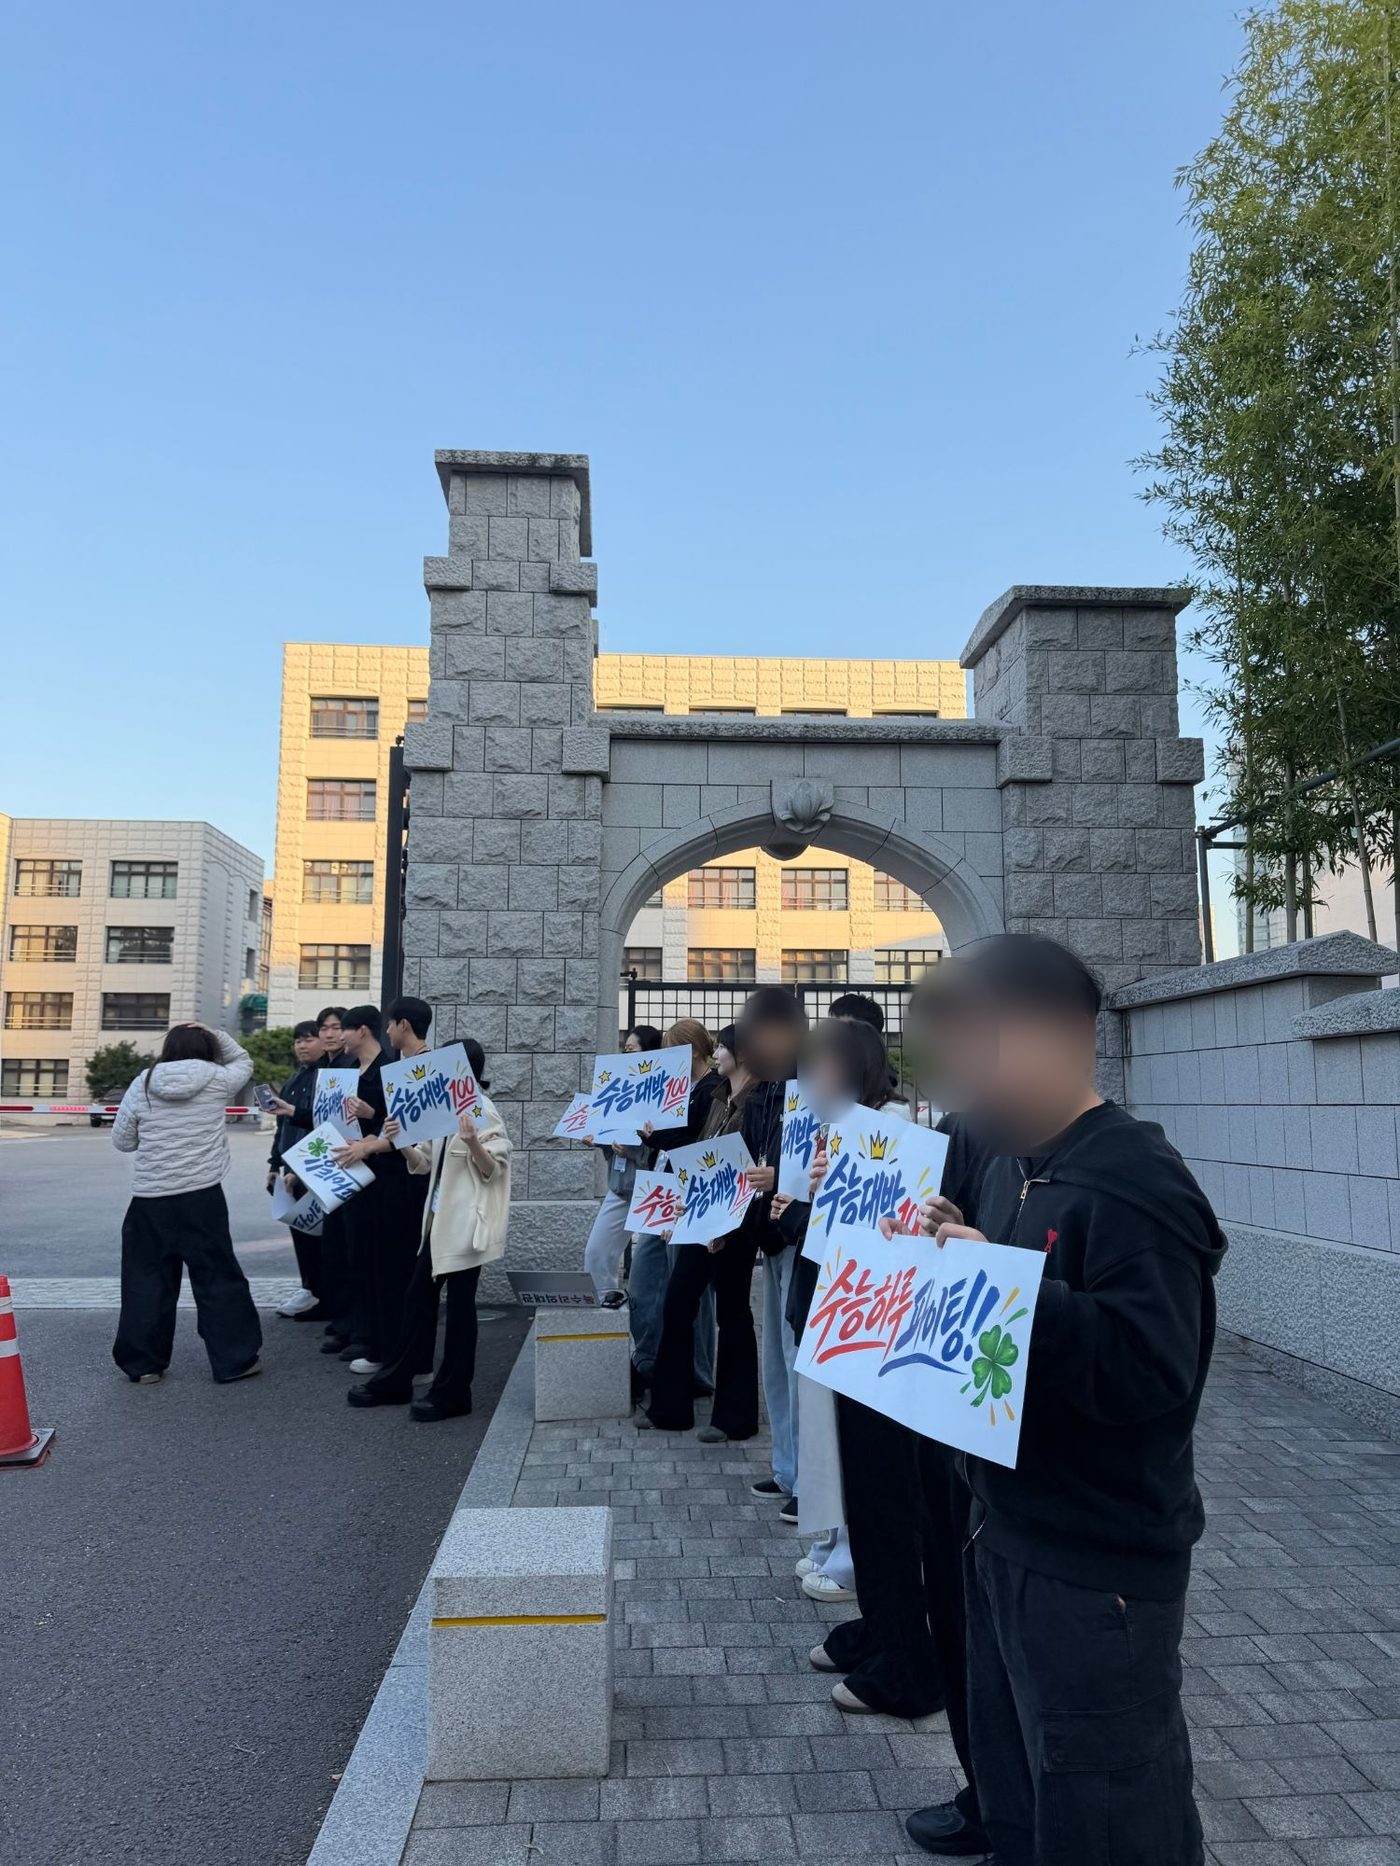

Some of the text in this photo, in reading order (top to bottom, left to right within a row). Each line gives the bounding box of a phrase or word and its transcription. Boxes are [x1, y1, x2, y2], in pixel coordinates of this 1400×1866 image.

[390, 1073, 475, 1131] 수능대박 100
[593, 1069, 689, 1118] 수능대박 100
[685, 1162, 738, 1228] 수능대박
[898, 1197, 923, 1236] 10
[809, 1258, 1000, 1362] 수능하루 파이팅!!
